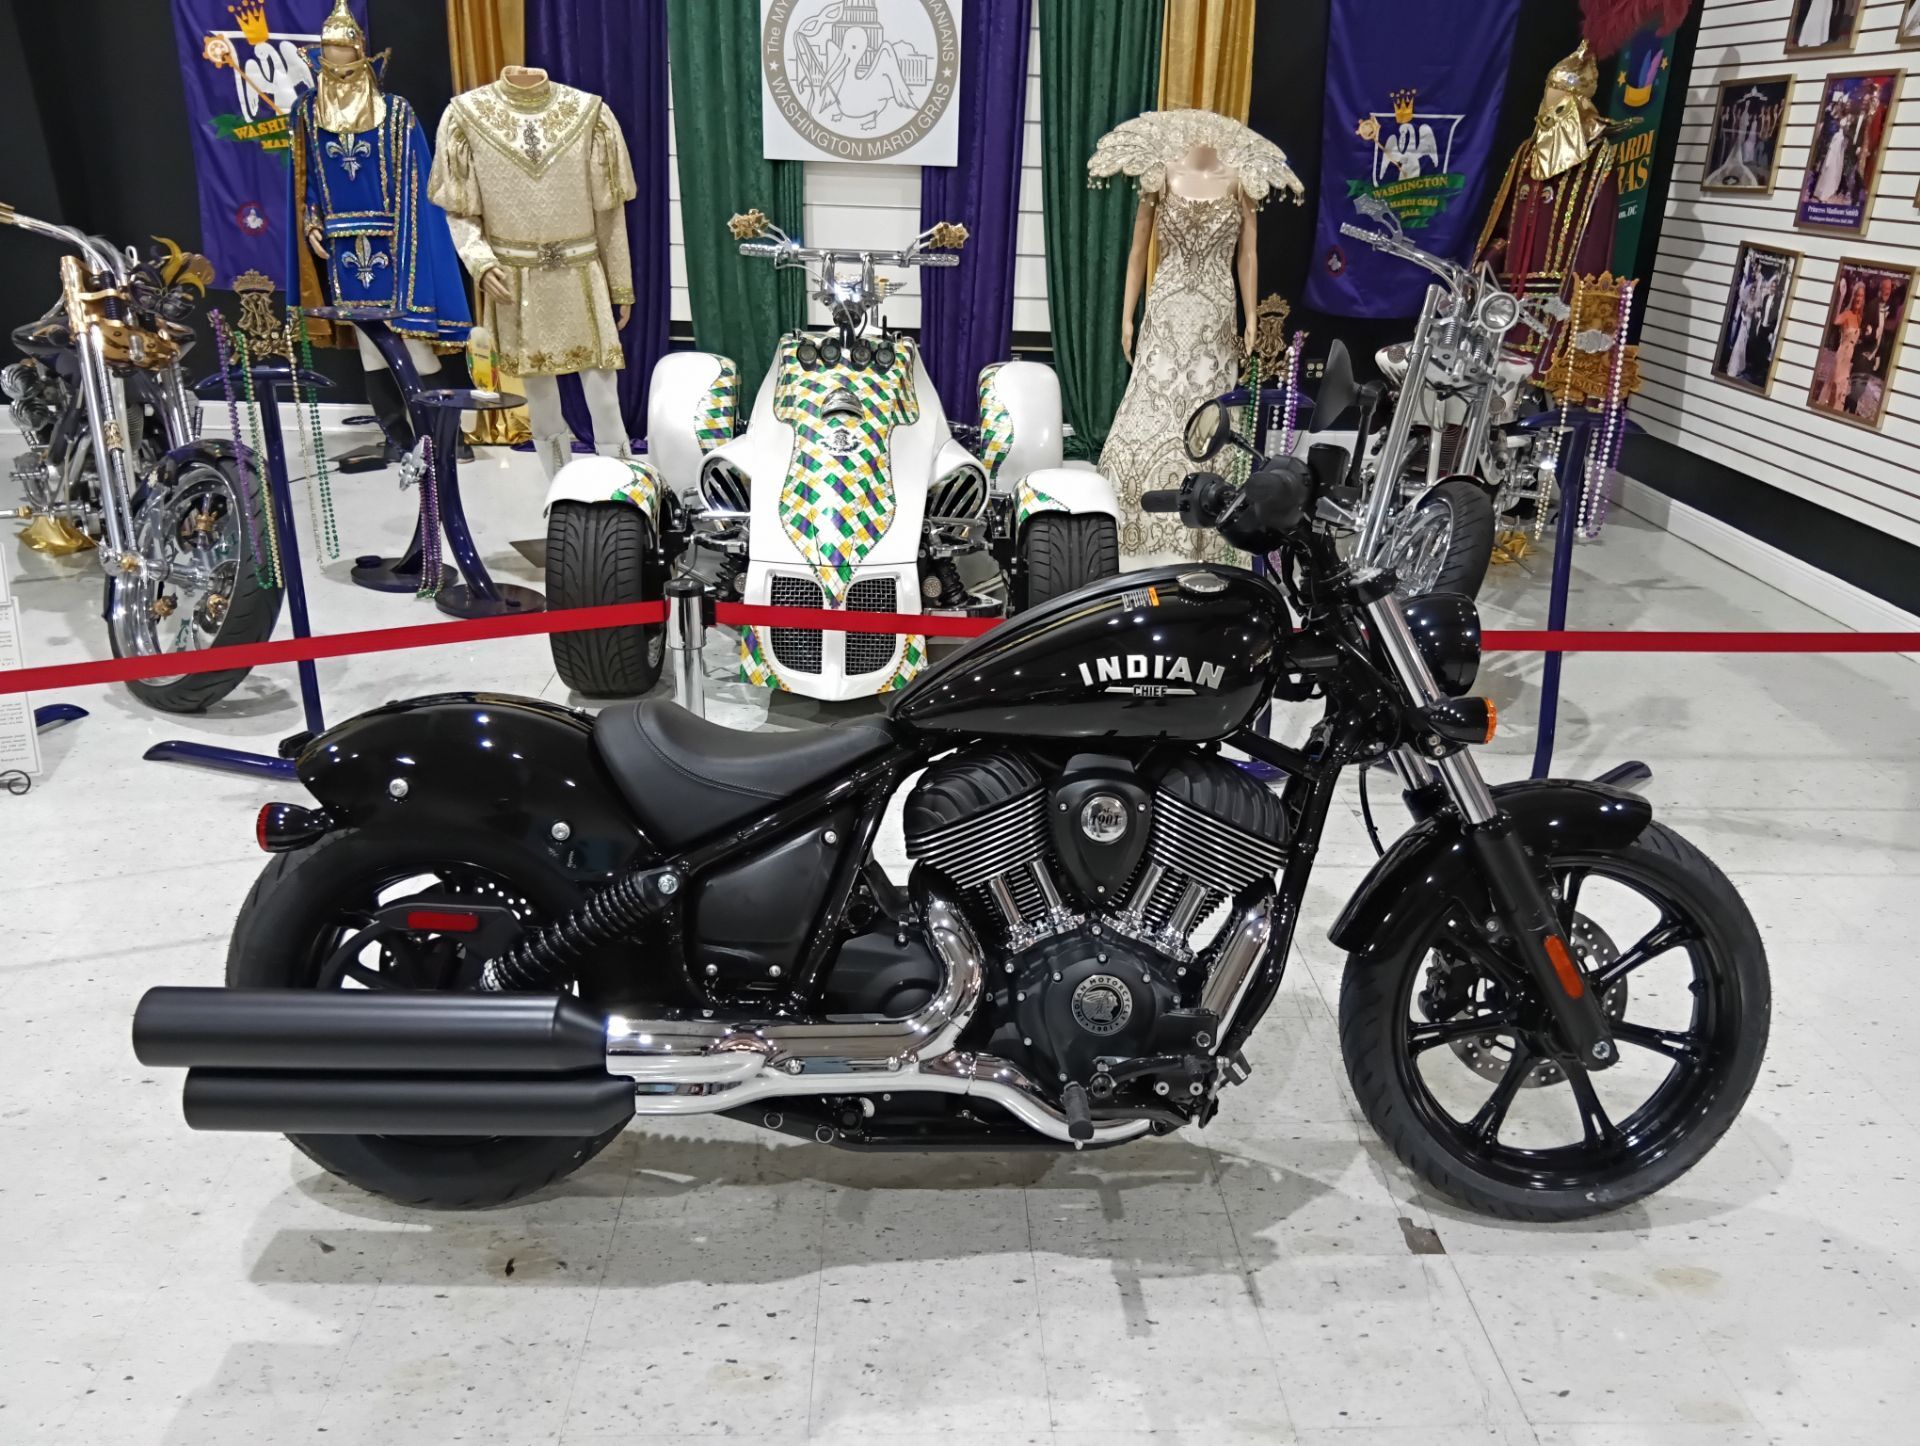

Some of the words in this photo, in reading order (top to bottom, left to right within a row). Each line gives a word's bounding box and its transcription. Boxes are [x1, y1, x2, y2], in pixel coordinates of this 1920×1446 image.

[767, 26, 781, 54] The
[929, 0, 954, 61] ANIANS
[233, 117, 287, 140] WASHI
[772, 76, 862, 156] WASHINGTON
[868, 127, 919, 156] MARDI
[918, 83, 949, 129] GRAS
[1615, 129, 1656, 164] ARDI
[1373, 176, 1448, 199] WASHINGTON
[1078, 654, 1226, 690] INDIAN
[1133, 684, 1168, 697] CHIEF
[1091, 814, 1120, 826] 1901
[1089, 977, 1130, 1020] MOTORCYCLE
